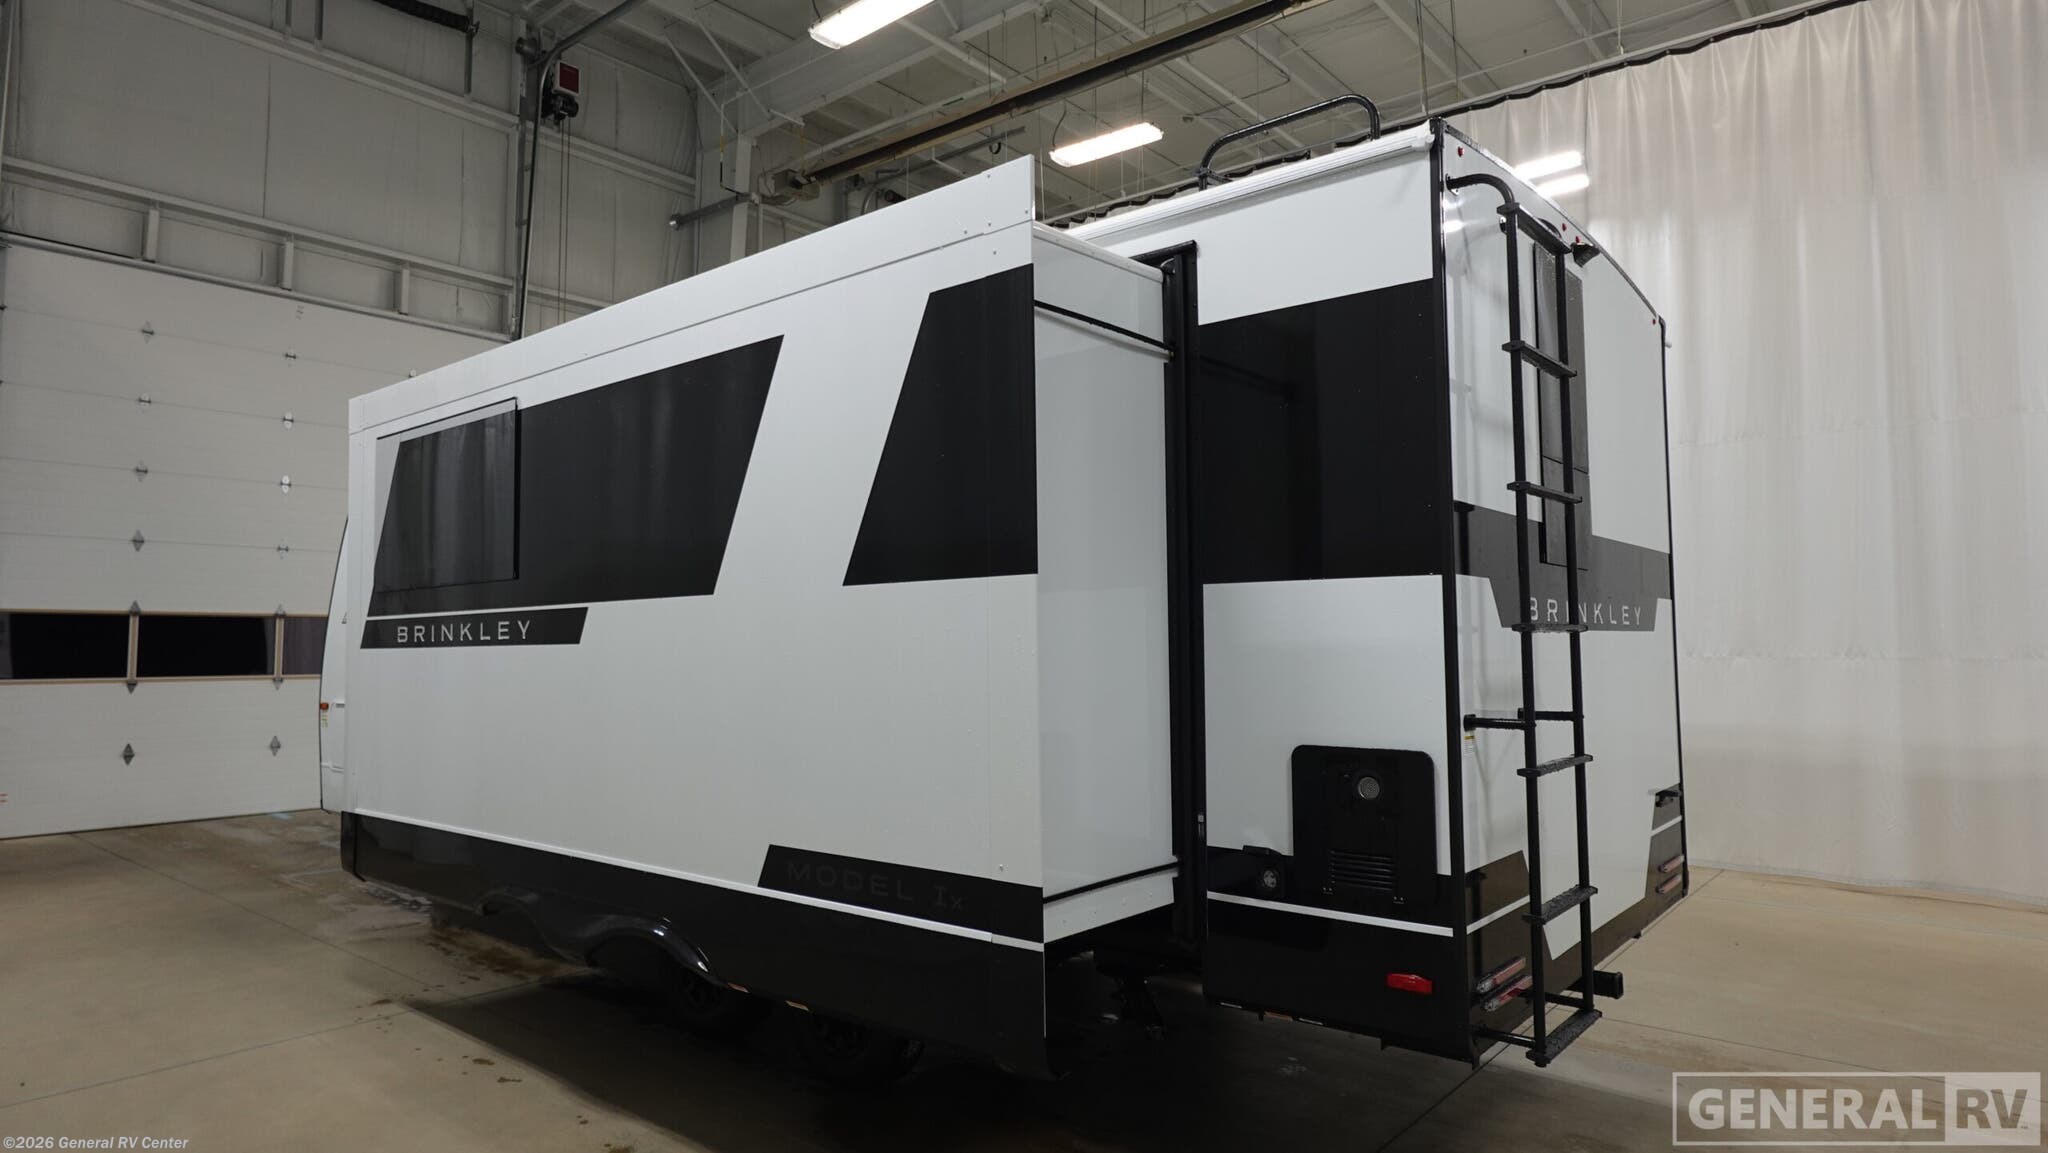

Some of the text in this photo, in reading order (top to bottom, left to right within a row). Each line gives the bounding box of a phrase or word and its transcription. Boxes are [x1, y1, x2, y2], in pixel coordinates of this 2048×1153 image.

[1530, 597, 1641, 625] BRINKLEY
[397, 620, 530, 643] BRINKLEY
[787, 861, 914, 902] MODEL
